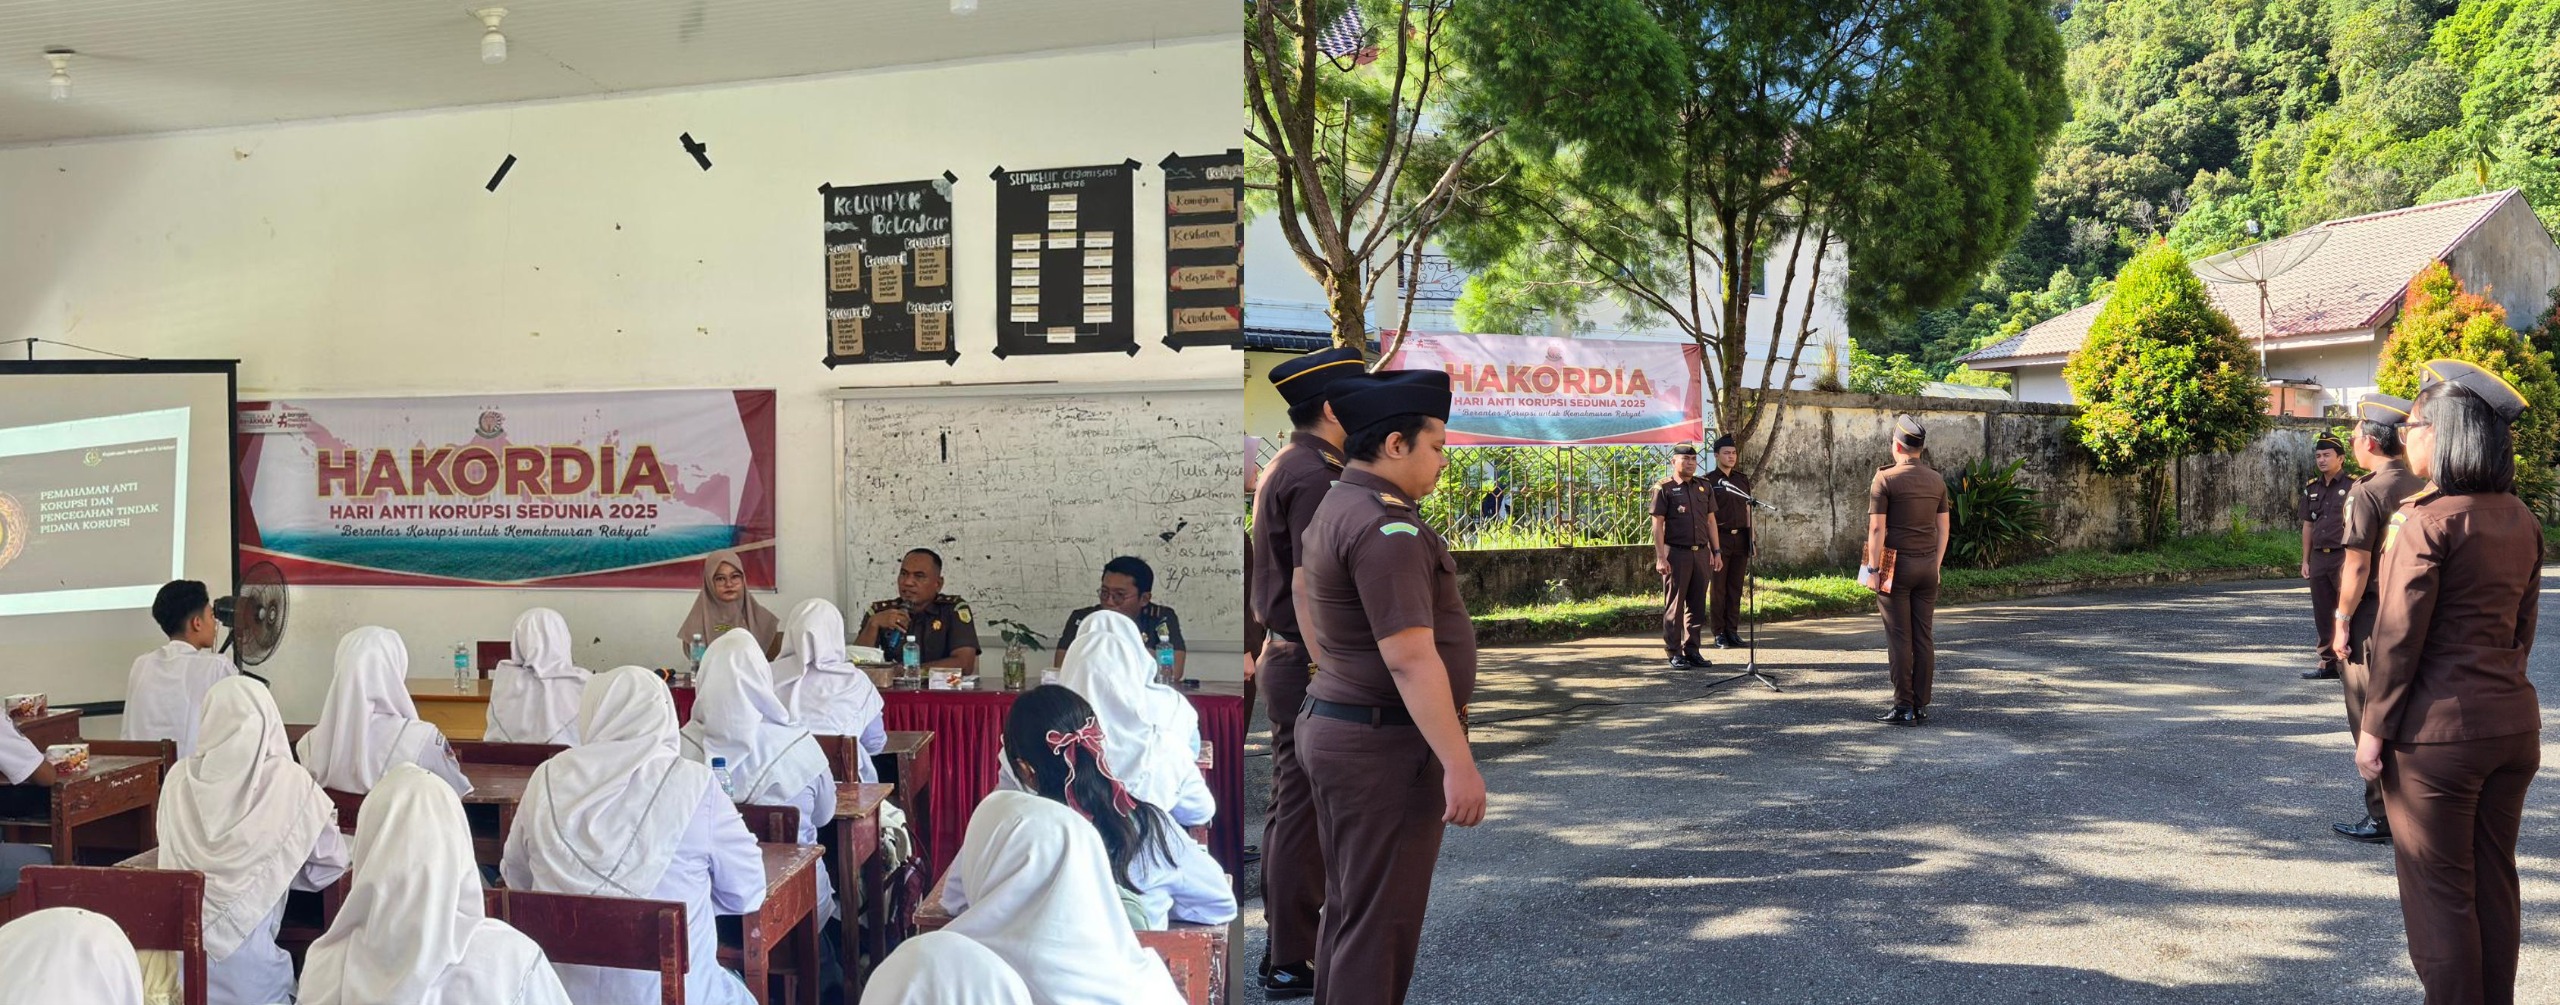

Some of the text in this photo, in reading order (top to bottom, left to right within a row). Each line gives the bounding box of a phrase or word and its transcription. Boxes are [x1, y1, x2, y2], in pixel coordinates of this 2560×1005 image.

[1445, 363, 1653, 396] HAKORDIA
[1454, 397, 1646, 408] HARI ANTI KORUPSI SEDUNIA 2025
[1504, 409, 1536, 418] Korupsi
[1538, 409, 1560, 417] untuk
[317, 445, 673, 498] HAKORDIA
[1170, 459, 1207, 480] Tulis
[40, 482, 138, 500] PEMAHAMAN ANTI
[40, 496, 114, 512] KORUPSI DAN
[330, 504, 658, 520] HARI ANTI KORUPSI SEDUNIA 2025
[40, 503, 159, 523] PENCEGAHAN TINDAK
[40, 518, 130, 534] PIDANA KORUPSI
[406, 524, 460, 541] Korupsi
[462, 524, 500, 538] untuk
[504, 524, 594, 538] Kemakmuran
